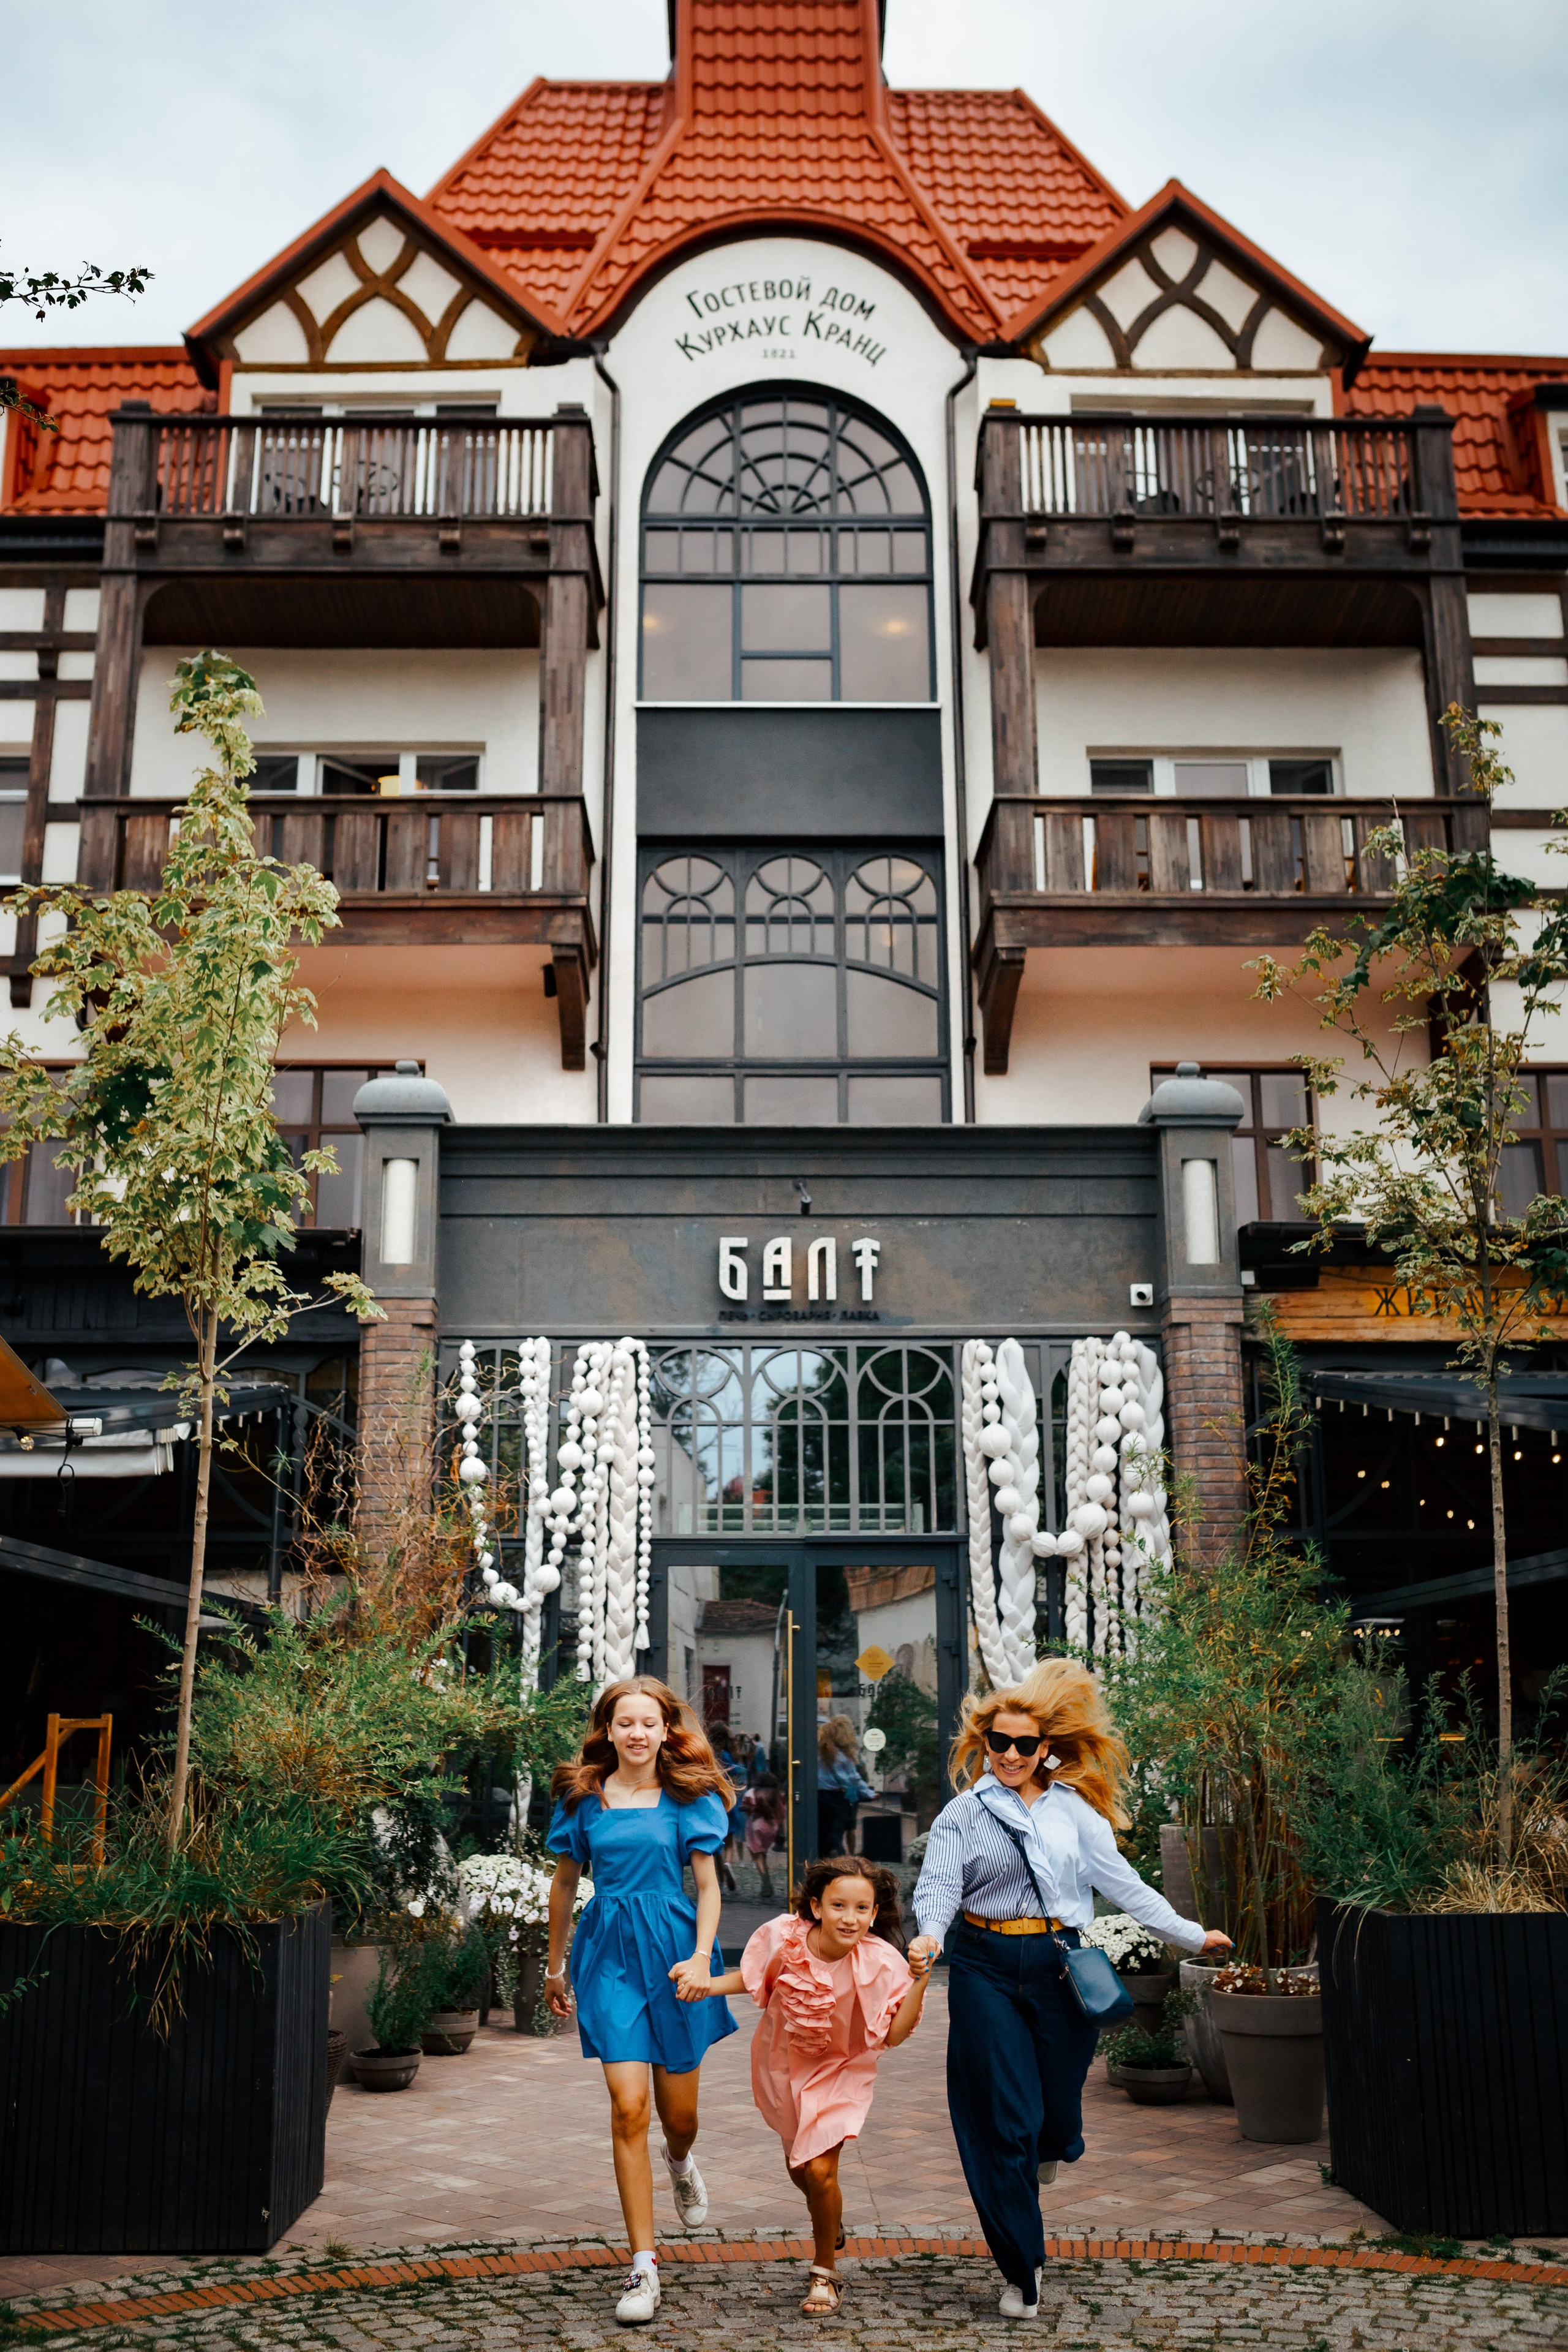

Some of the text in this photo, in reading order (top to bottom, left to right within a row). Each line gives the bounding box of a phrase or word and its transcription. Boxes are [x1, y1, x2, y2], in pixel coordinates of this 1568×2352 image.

[686, 276, 876, 322] ГОСТЕВОЙ ДОМ
[674, 310, 888, 368] КУРХАУС КРАНЦ
[719, 1237, 881, 1300] БАЛТ
